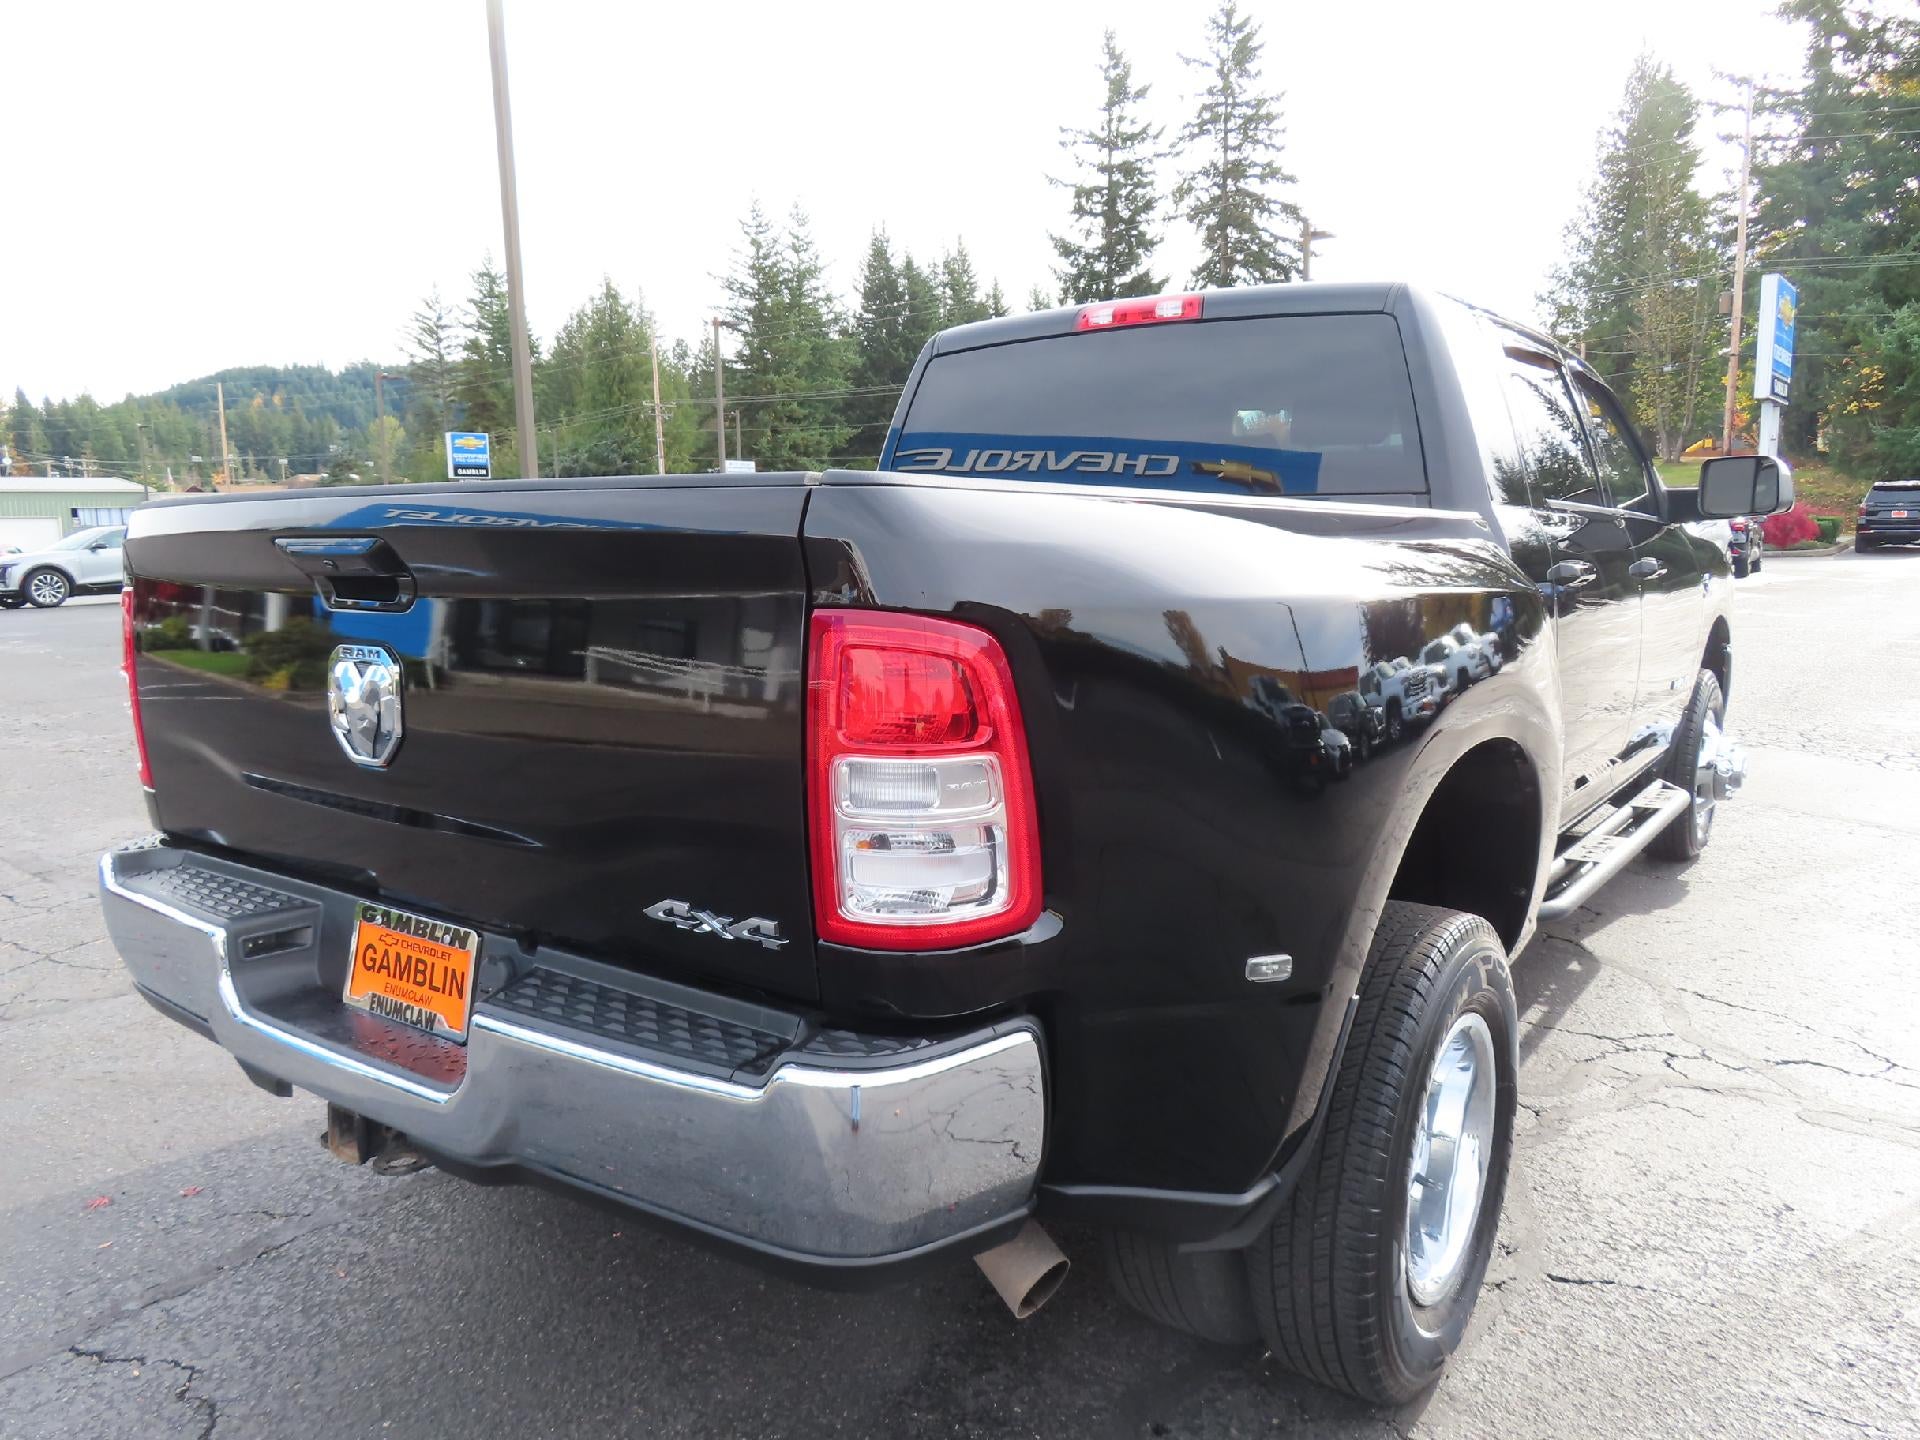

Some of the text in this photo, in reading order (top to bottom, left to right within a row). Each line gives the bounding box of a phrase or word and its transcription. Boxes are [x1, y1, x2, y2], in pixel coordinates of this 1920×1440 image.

[339, 647, 382, 659] RAM
[361, 904, 472, 950] GAMBLIN
[400, 939, 453, 962] CHEVROLET
[361, 943, 466, 1000] GAMBLIN
[383, 982, 433, 1007] ENUMCLAW
[369, 992, 438, 1031] ENUMCLAW
